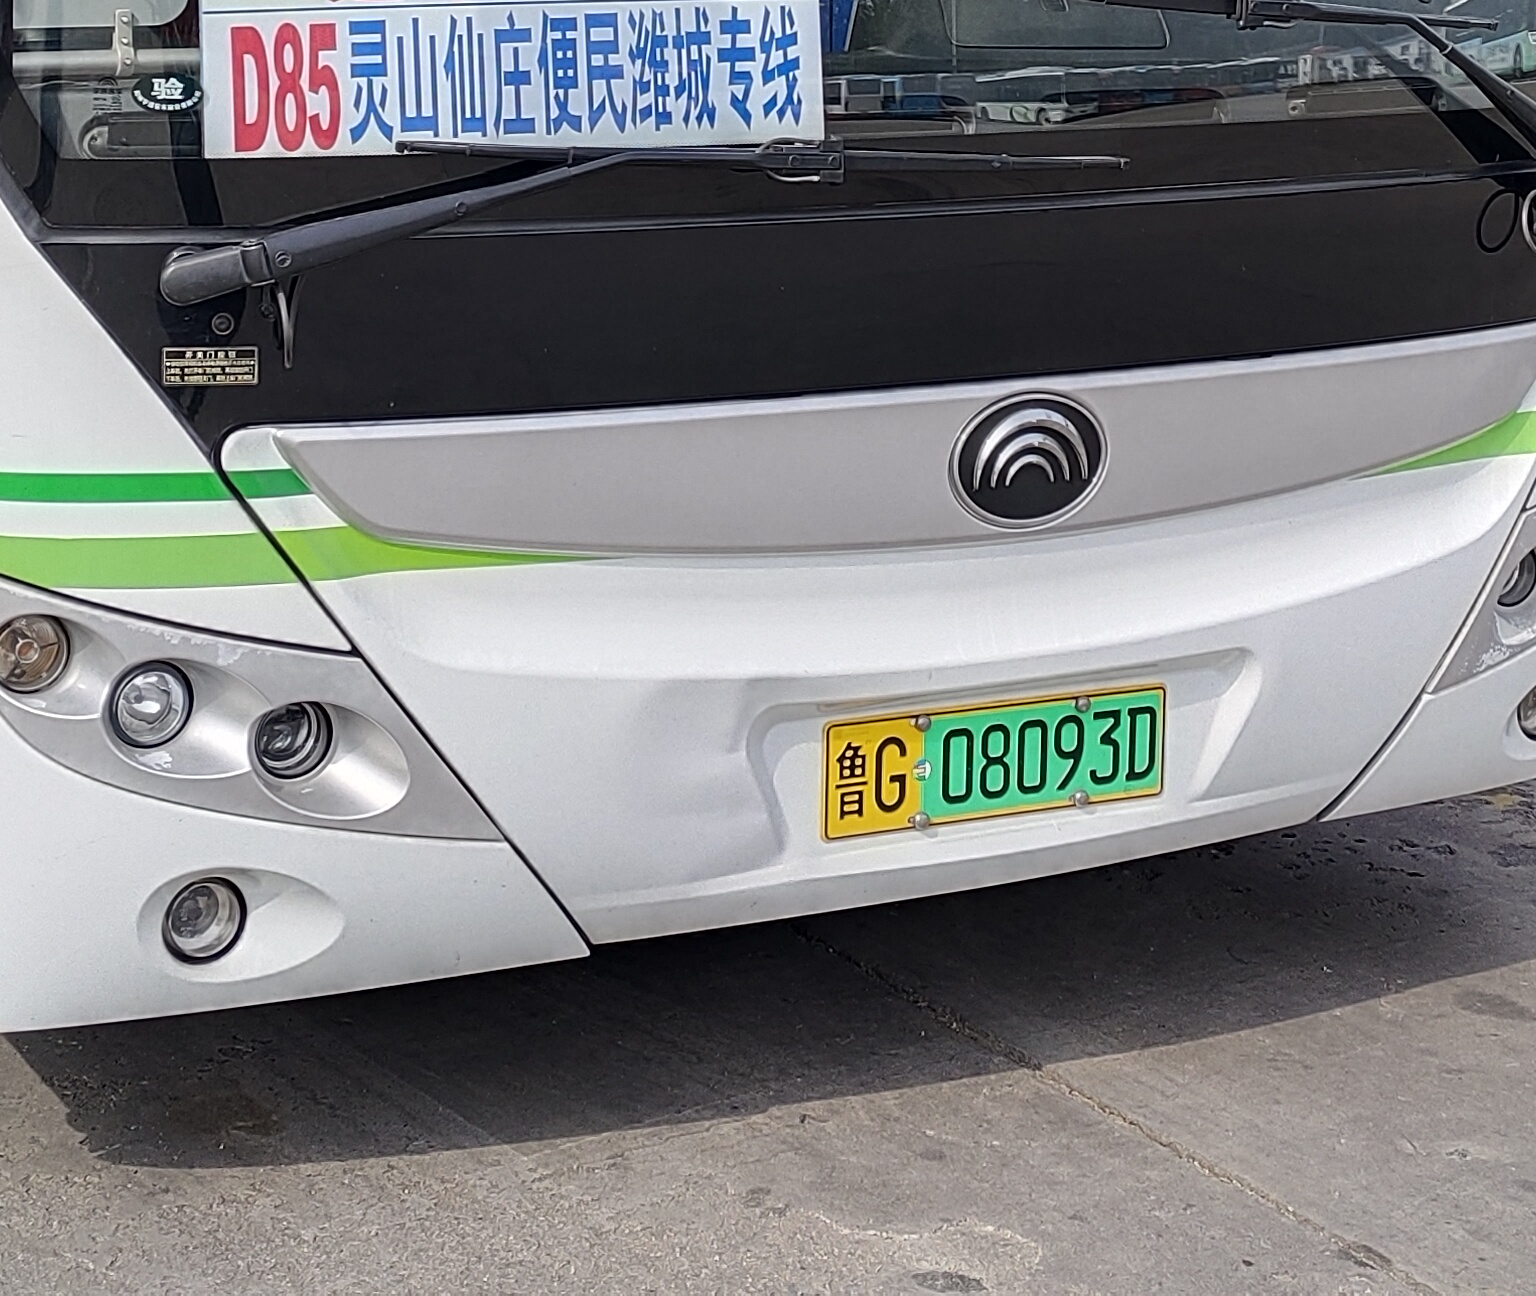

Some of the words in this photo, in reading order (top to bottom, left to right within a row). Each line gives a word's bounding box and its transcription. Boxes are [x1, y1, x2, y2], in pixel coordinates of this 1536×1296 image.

[151, 77, 185, 99] 验
[230, 22, 341, 153] D85
[347, 5, 804, 145] 灵山仙庄便民潍城专线
[835, 736, 907, 820] 鲁G
[941, 705, 1158, 805] 08093D
